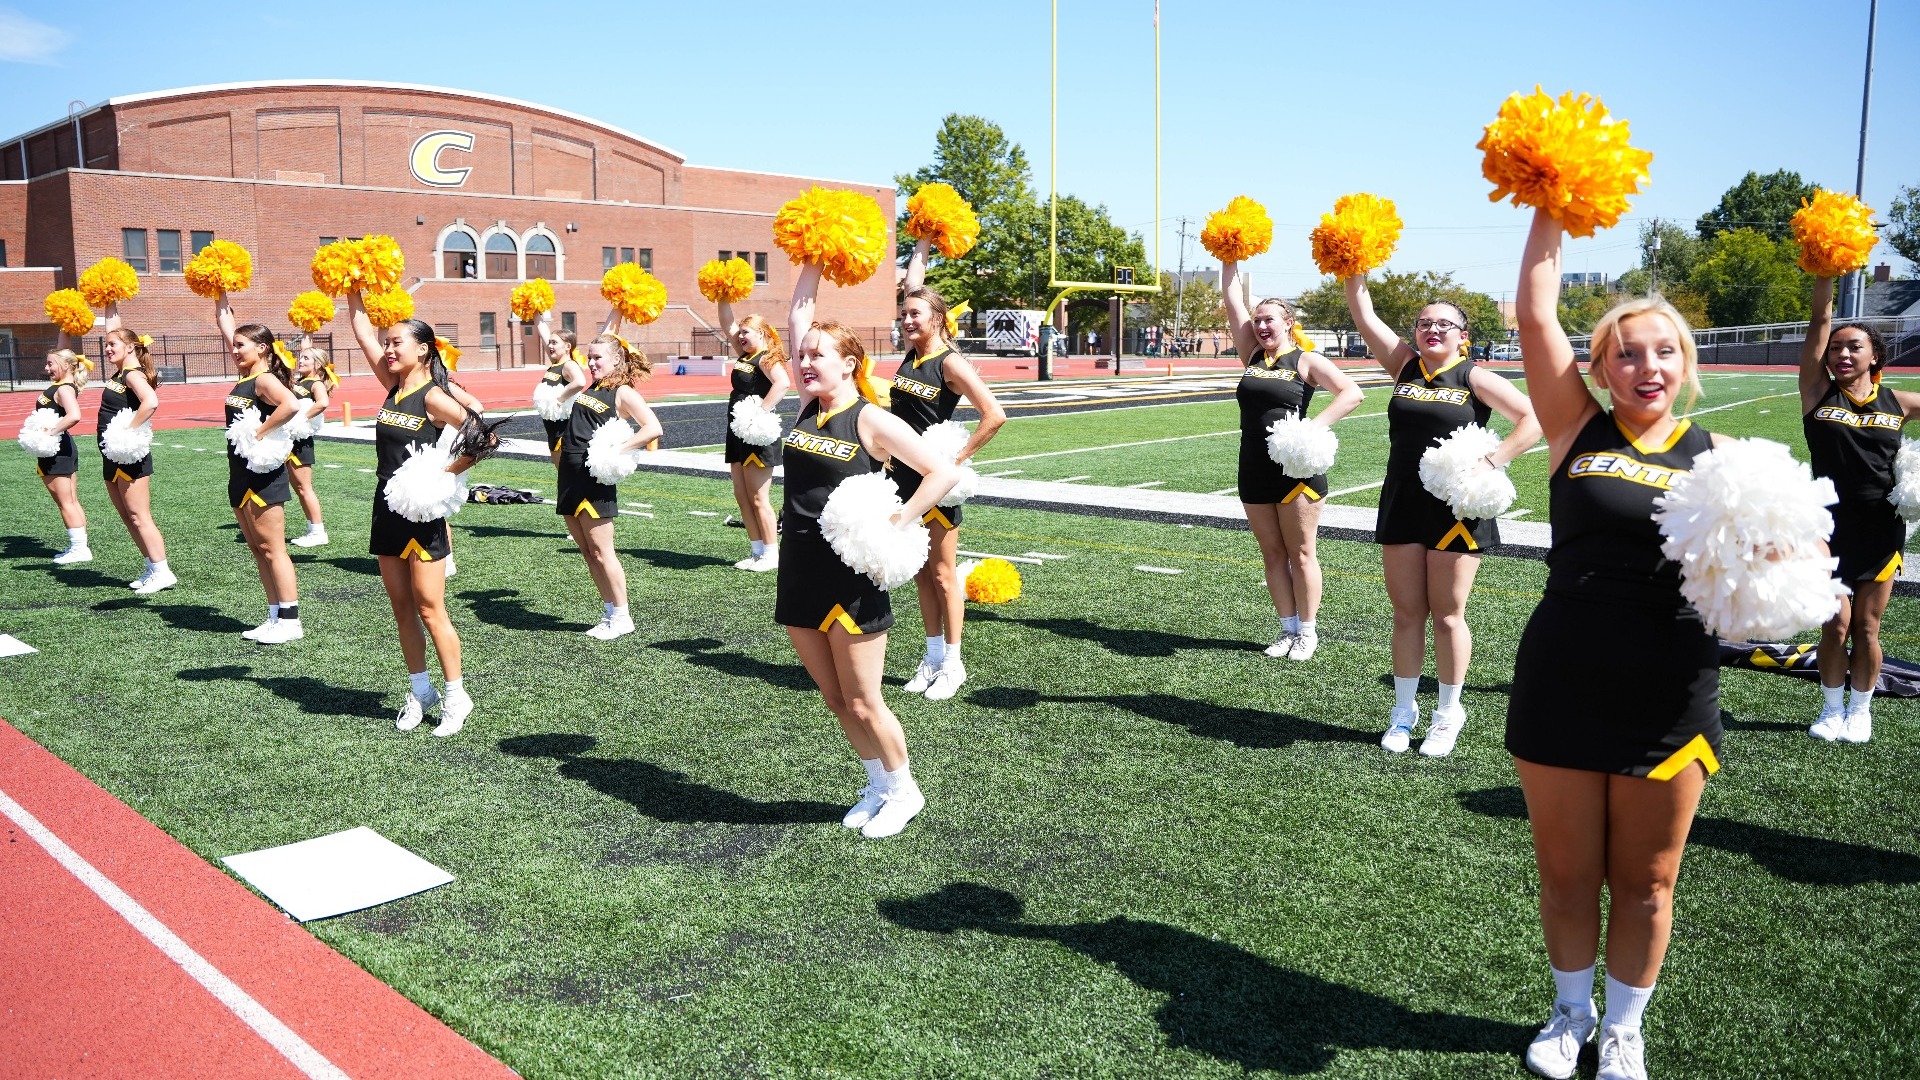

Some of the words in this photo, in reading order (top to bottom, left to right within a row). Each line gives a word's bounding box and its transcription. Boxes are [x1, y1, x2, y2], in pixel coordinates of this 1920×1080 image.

[409, 130, 475, 188] C
[1244, 366, 1296, 380] ENTRE
[893, 375, 940, 400] NTRE
[377, 409, 425, 430] ENTRE
[1815, 407, 1903, 430] CENTRE
[786, 430, 859, 461] ENTRE
[1569, 453, 1687, 489] CENT
